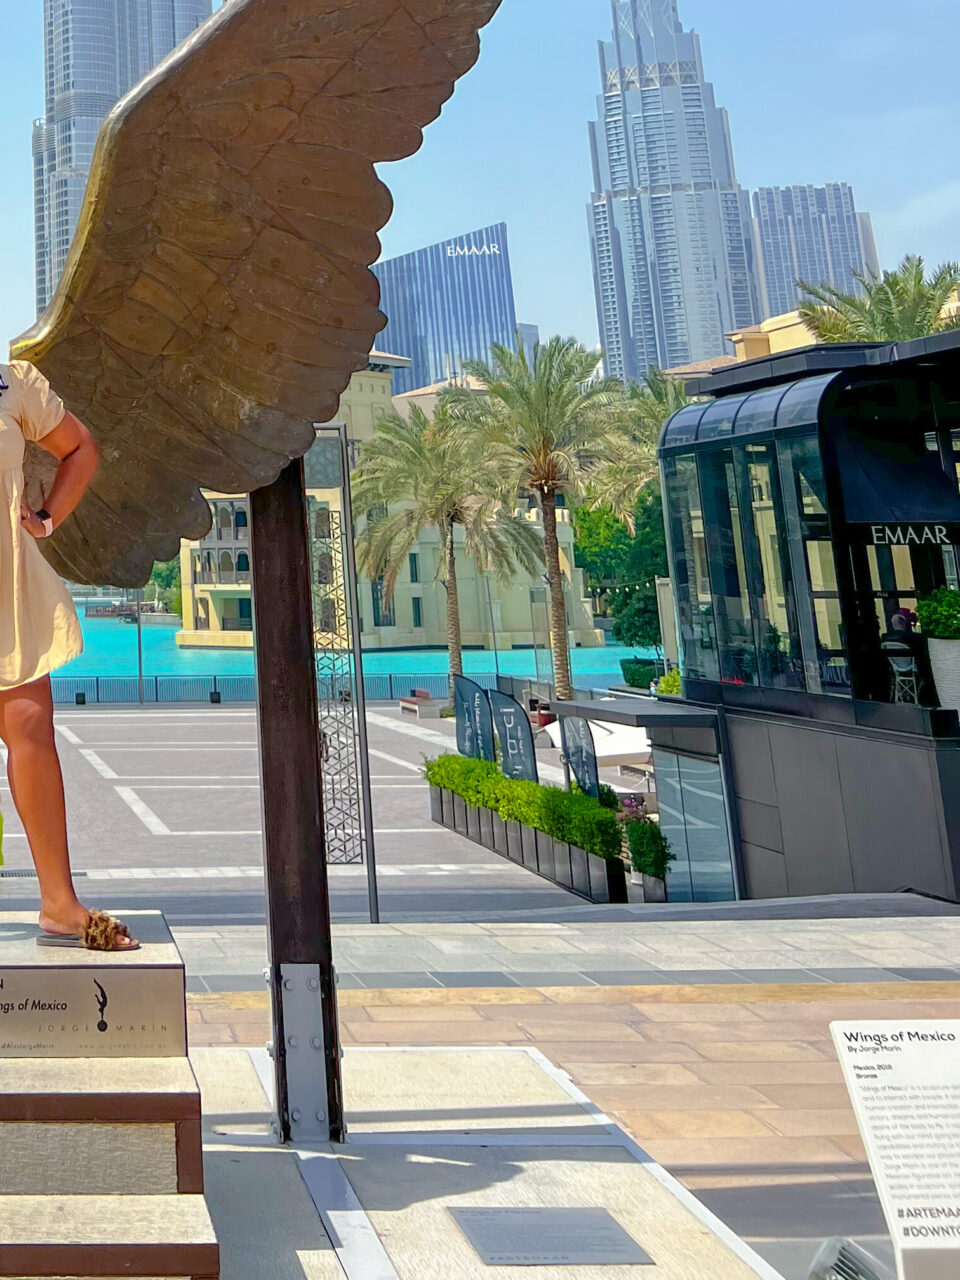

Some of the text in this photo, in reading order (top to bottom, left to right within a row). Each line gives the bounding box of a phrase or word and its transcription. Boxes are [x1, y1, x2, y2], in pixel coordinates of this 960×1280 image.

[447, 243, 501, 257] EMAAR
[871, 525, 951, 544] EMAAR
[17, 998, 30, 1011] of
[30, 999, 68, 1011] Mexico
[843, 1031, 956, 1045] Wings of Mexico
[847, 1045, 858, 1054] By
[858, 1045, 880, 1054] Jorge
